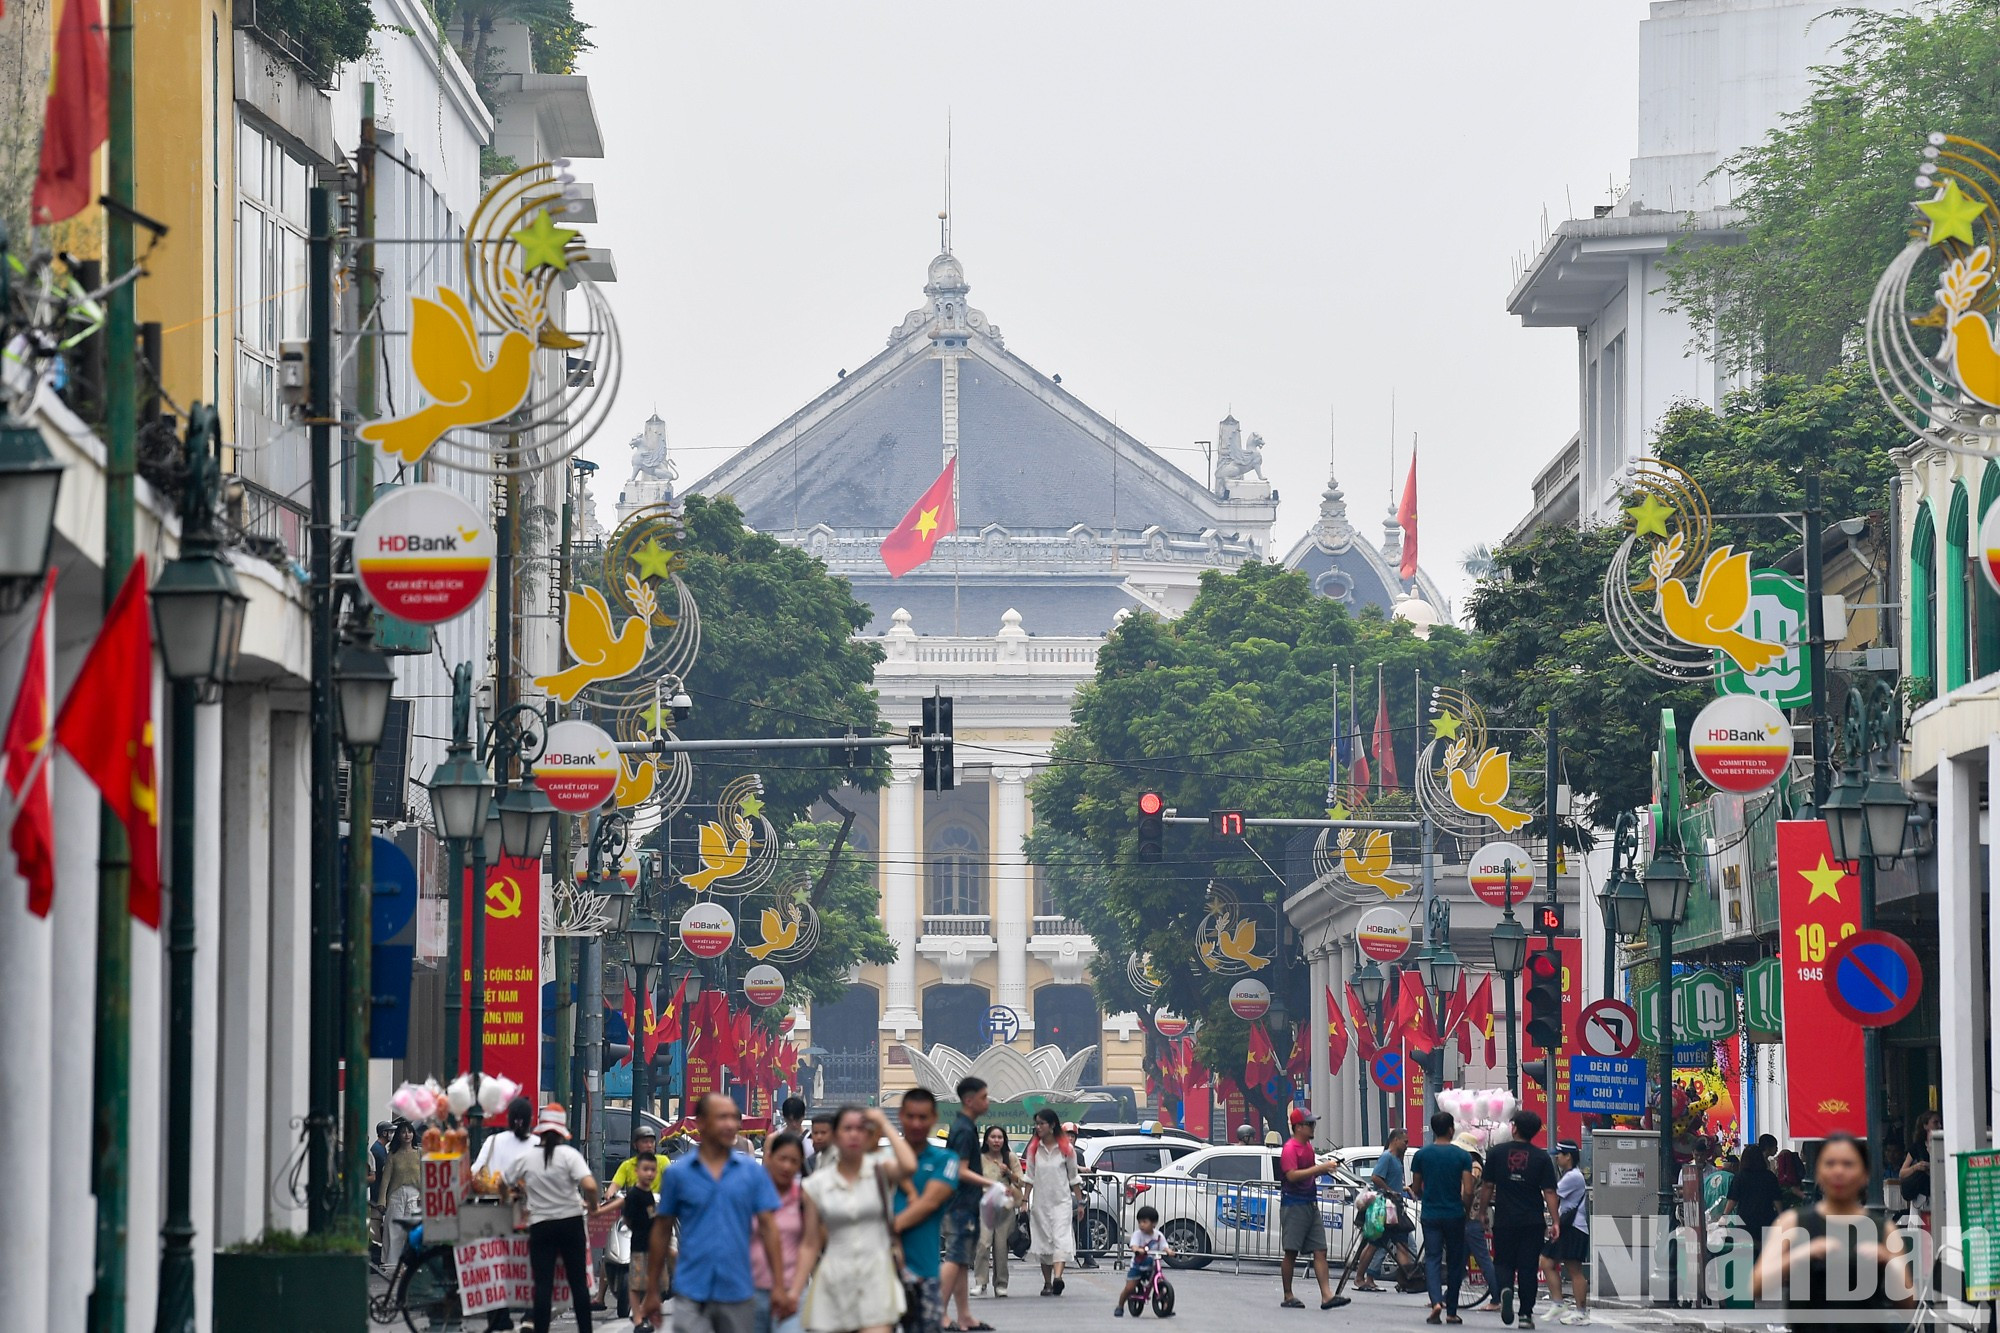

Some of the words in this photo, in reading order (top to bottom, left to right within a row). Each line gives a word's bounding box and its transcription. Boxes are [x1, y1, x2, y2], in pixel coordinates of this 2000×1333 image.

[379, 535, 457, 551] HDBank
[1709, 729, 1765, 741] HDBank
[544, 754, 596, 765] HDBank
[1222, 814, 1242, 835] 17
[690, 921, 721, 930] HDBank
[1367, 925, 1397, 934] HDBank
[1797, 967, 1823, 981] 1945
[498, 990, 518, 1003] NAM
[503, 1011, 523, 1024] VINH
[1590, 1060, 1610, 1072] ĐÈN
[1968, 1156, 1991, 1168] KEM
[425, 1188, 457, 1217] BÍA
